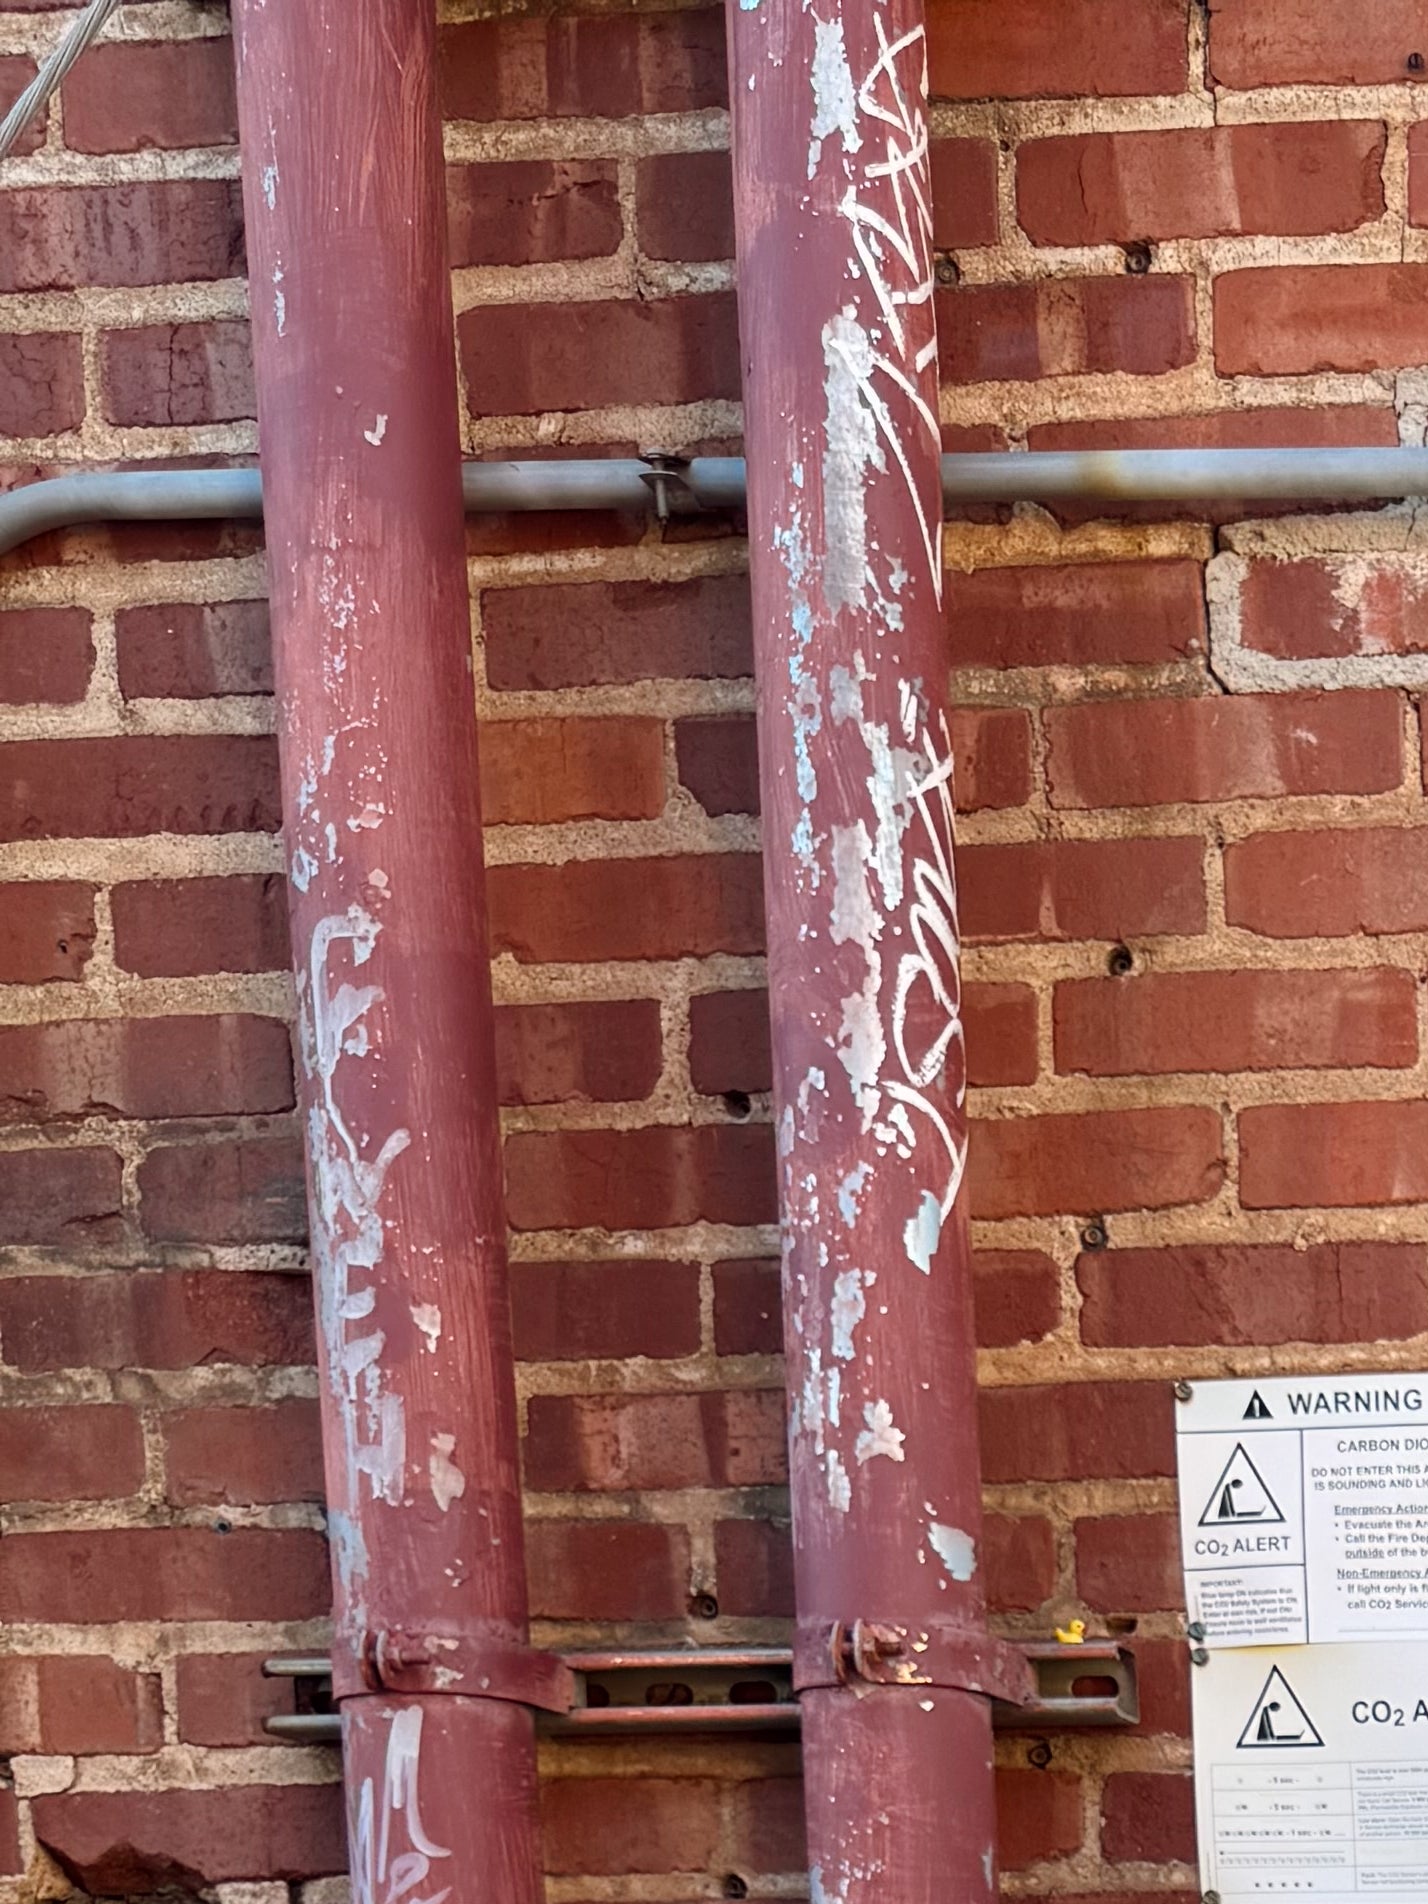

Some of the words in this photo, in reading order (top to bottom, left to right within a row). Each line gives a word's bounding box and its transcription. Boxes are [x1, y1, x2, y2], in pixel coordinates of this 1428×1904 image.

[1287, 1389, 1423, 1415] WARNING
[1337, 1440, 1400, 1453] CARBON
[1311, 1466, 1327, 1477] DO
[1330, 1466, 1352, 1477] NOT
[1356, 1465, 1393, 1476] ENTER
[1396, 1464, 1421, 1475] THIS
[1314, 1480, 1325, 1490] IS
[1328, 1479, 1386, 1490] SOUNDING
[1389, 1478, 1413, 1489] AND
[1334, 1505, 1393, 1516] Emergency
[1345, 1521, 1393, 1529] Evacuate
[1396, 1519, 1412, 1529] the
[1233, 1536, 1291, 1552] ALERT
[1345, 1534, 1365, 1543] Call
[1368, 1533, 1385, 1543] the
[1388, 1533, 1408, 1543] Fire
[1345, 1548, 1385, 1559] outside
[1387, 1548, 1398, 1557] of
[1401, 1548, 1418, 1557] the
[1337, 1568, 1422, 1580] Non-Emergency
[1348, 1584, 1355, 1593] If
[1357, 1583, 1381, 1595] light
[1384, 1584, 1407, 1595] only
[1409, 1583, 1419, 1593] is
[1347, 1599, 1366, 1609] call
[1368, 1599, 1392, 1609] CO2
